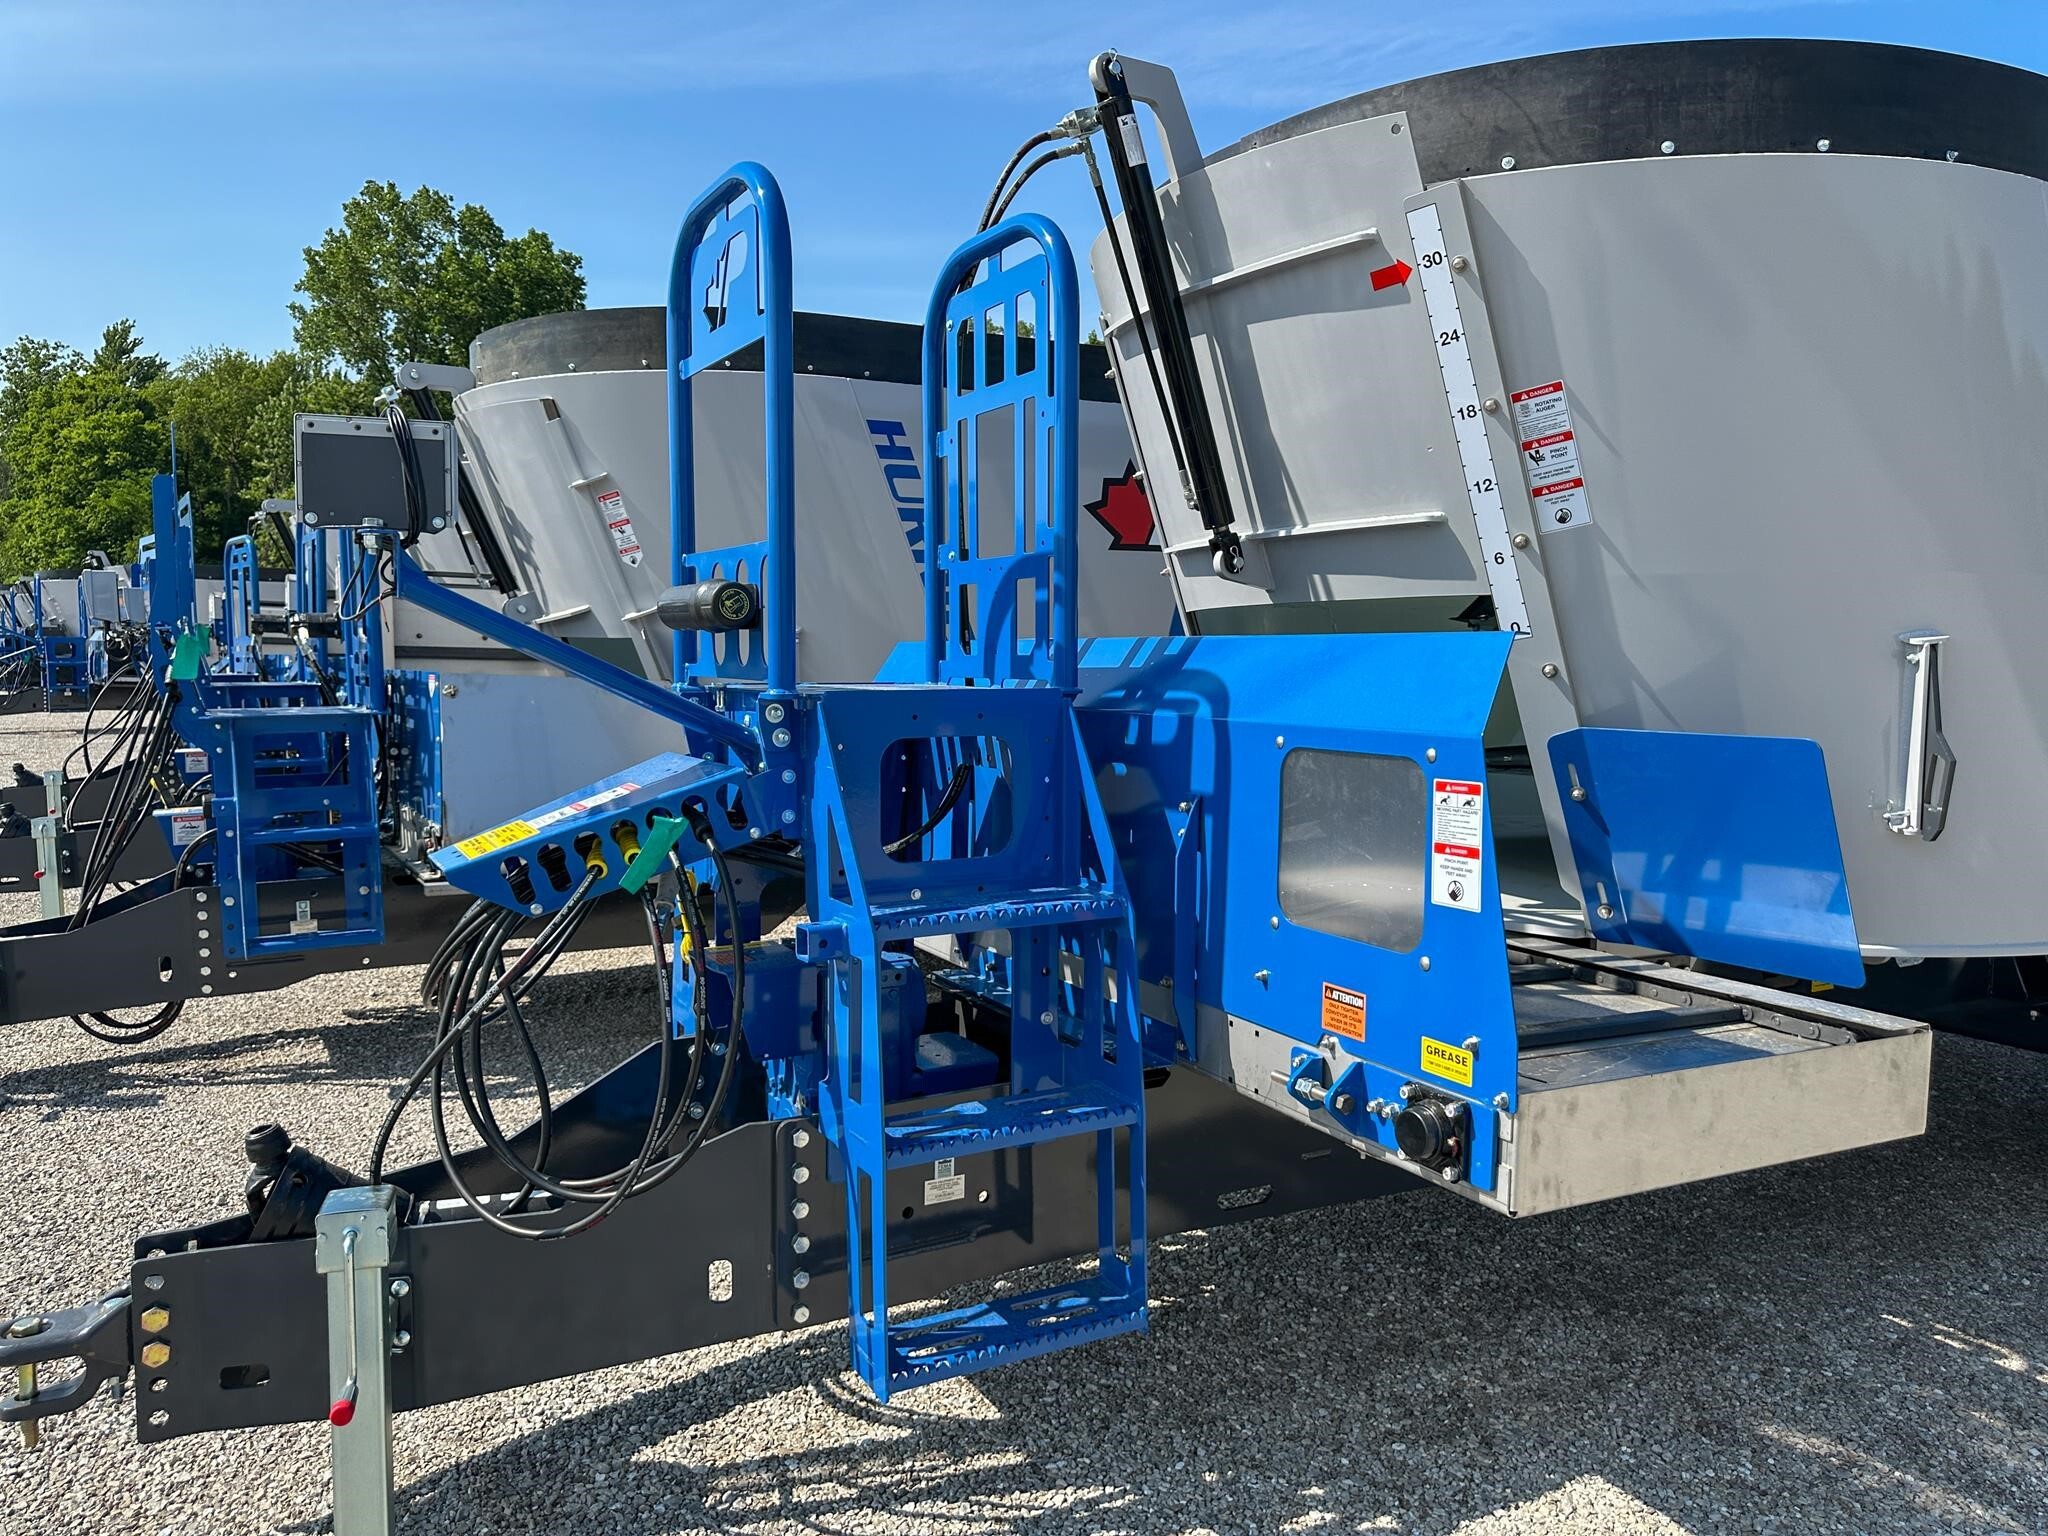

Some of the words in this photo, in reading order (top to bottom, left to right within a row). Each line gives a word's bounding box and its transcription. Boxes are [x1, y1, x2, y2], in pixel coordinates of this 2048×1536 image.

[1421, 250, 1443, 269] 30
[1439, 328, 1461, 347] 24
[1529, 386, 1554, 398] DANGER
[1534, 396, 1563, 408] ROTATING
[1456, 404, 1478, 421] 18
[1535, 404, 1556, 413] AUGER
[1540, 435, 1565, 446] DANGER
[1549, 446, 1568, 455] PINCH
[1550, 451, 1568, 460] POINT
[1473, 478, 1495, 495] 12
[1550, 481, 1575, 492] DANGER
[1493, 551, 1505, 565] 6
[1510, 621, 1521, 632] 0
[1331, 990, 1363, 1009] ATTENTION
[1328, 1002, 1340, 1010] ONLY
[1325, 1008, 1348, 1019] CONVEYOR
[1324, 1021, 1342, 1031] LOWEST
[1341, 1026, 1363, 1038] POSITION
[1426, 1044, 1468, 1068] GREASE
